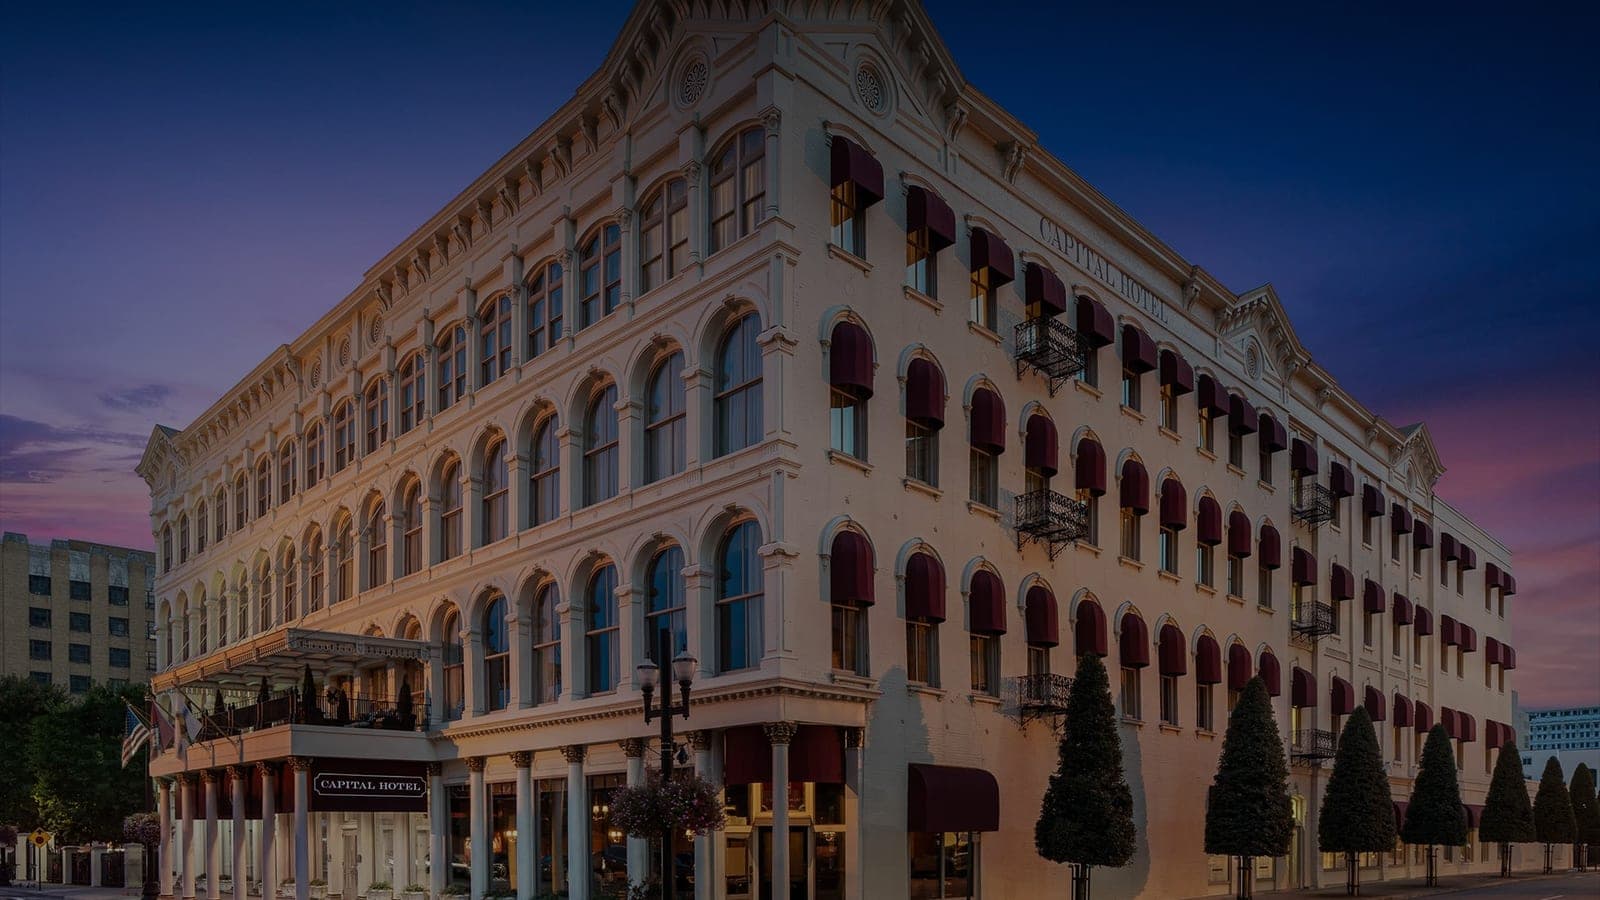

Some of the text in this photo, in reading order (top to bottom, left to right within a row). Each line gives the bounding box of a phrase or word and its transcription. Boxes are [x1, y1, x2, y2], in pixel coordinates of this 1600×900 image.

[1039, 216, 1168, 324] CAPITAL HOTEL
[320, 780, 421, 791] CAPITAL HOTEL
